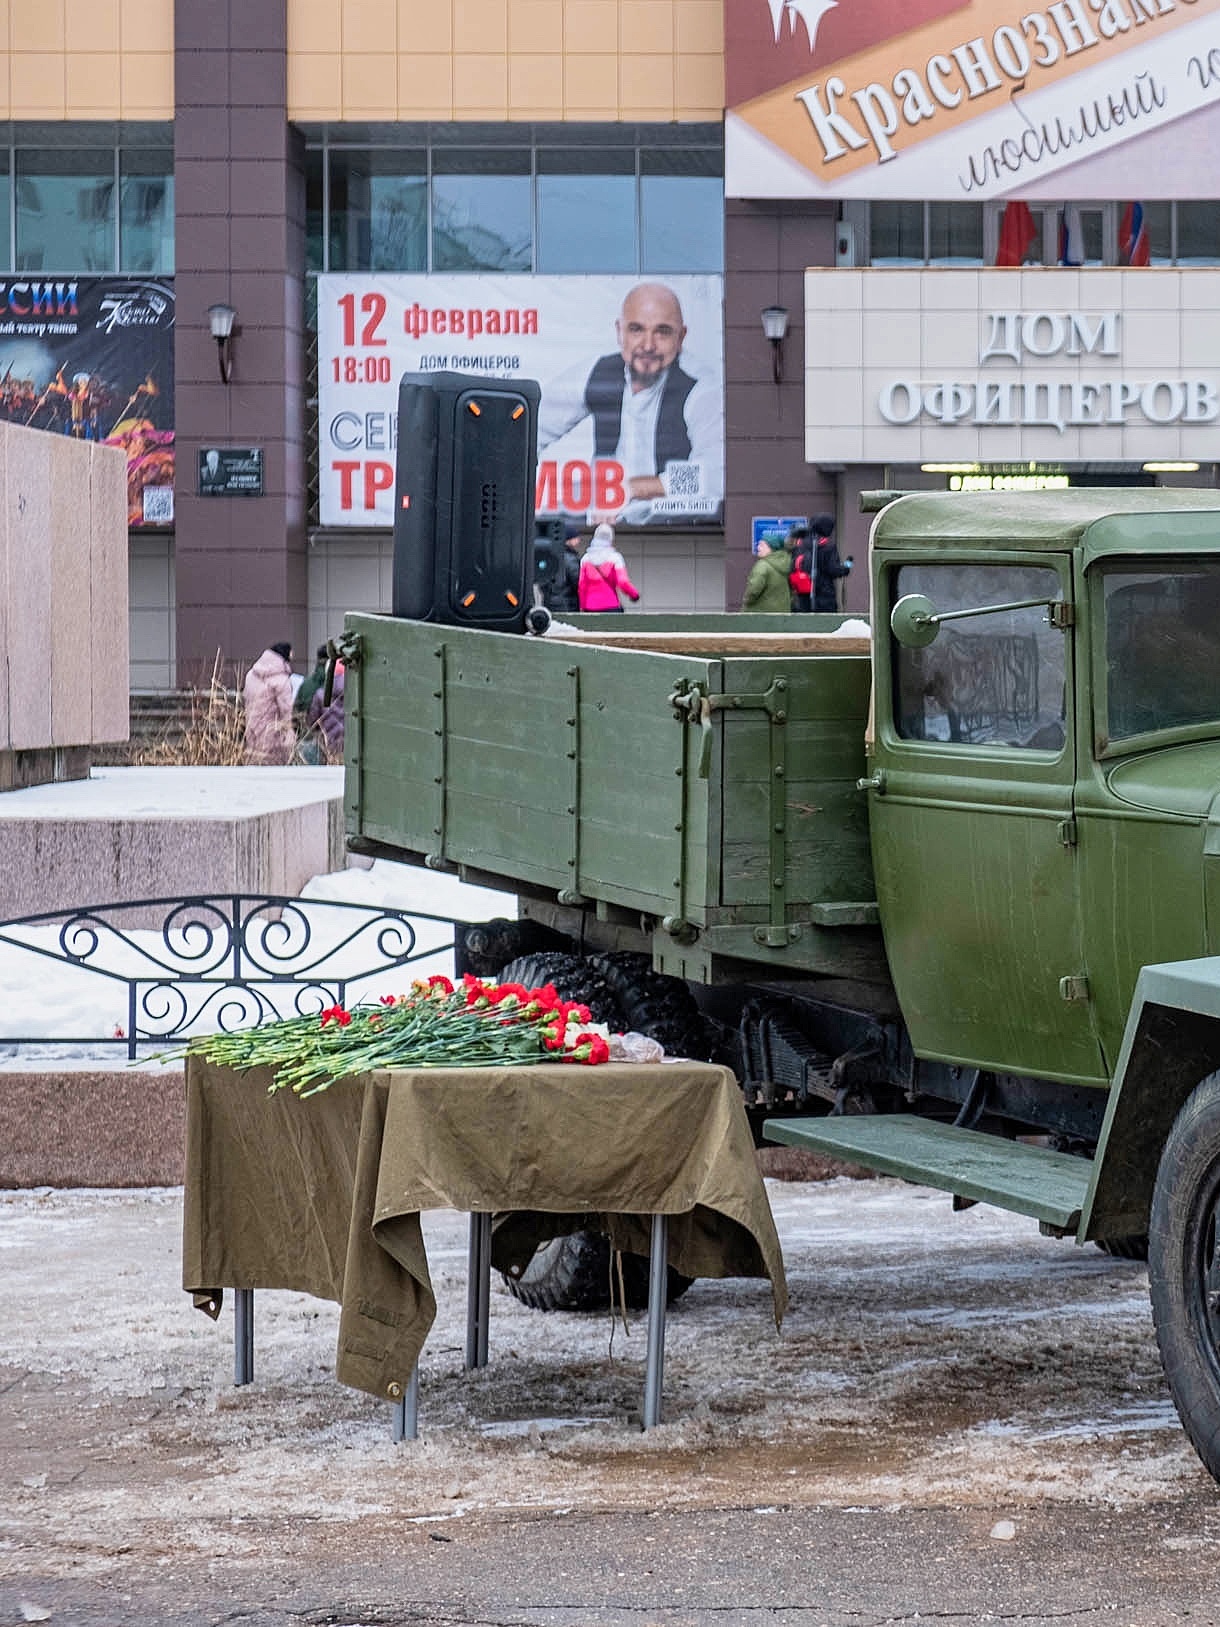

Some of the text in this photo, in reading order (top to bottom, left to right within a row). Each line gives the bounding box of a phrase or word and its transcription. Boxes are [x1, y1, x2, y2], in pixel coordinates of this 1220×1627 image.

[795, 0, 1198, 163] Краснознам
[959, 72, 1167, 191] любимый
[338, 293, 538, 347] 12 февраля
[978, 312, 1121, 366] ДОМ
[331, 356, 391, 383] 18:00
[419, 355, 520, 370] ДОМ ОФИЦЕРОВ
[878, 379, 1220, 434] ОФИЦЕРОВ
